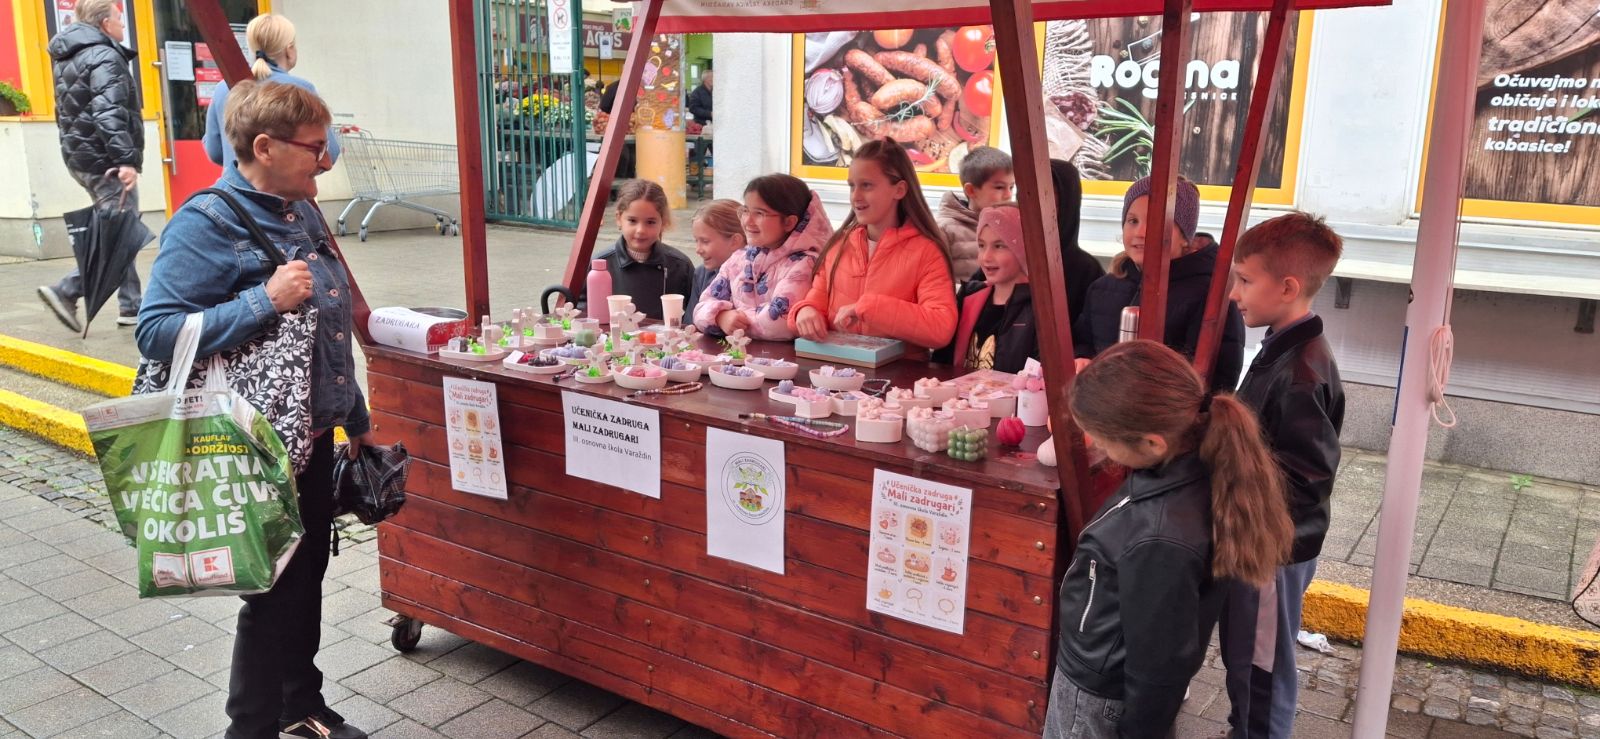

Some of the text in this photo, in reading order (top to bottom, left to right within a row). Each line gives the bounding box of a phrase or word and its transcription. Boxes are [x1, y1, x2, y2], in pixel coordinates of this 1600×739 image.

[1090, 55, 1240, 99] Rogna
[1494, 74, 1588, 91] Očuvajmo
[1490, 93, 1557, 111] običaje
[1560, 94, 1569, 108] i
[1488, 115, 1600, 134] tradicion
[1484, 138, 1572, 153] kobasice!
[571, 405, 650, 431] UČENIČKA ZADRUGA
[572, 421, 639, 444] MALI ZADRUGARI
[581, 438, 607, 450] osnovna
[608, 443, 623, 454] škola
[624, 448, 652, 461] Varaždin
[120, 484, 204, 515] VEĆICA
[887, 488, 956, 512] Mali zadrugari
[890, 480, 953, 503] Učenička zadruga
[143, 505, 247, 544] OKOLIŠ
